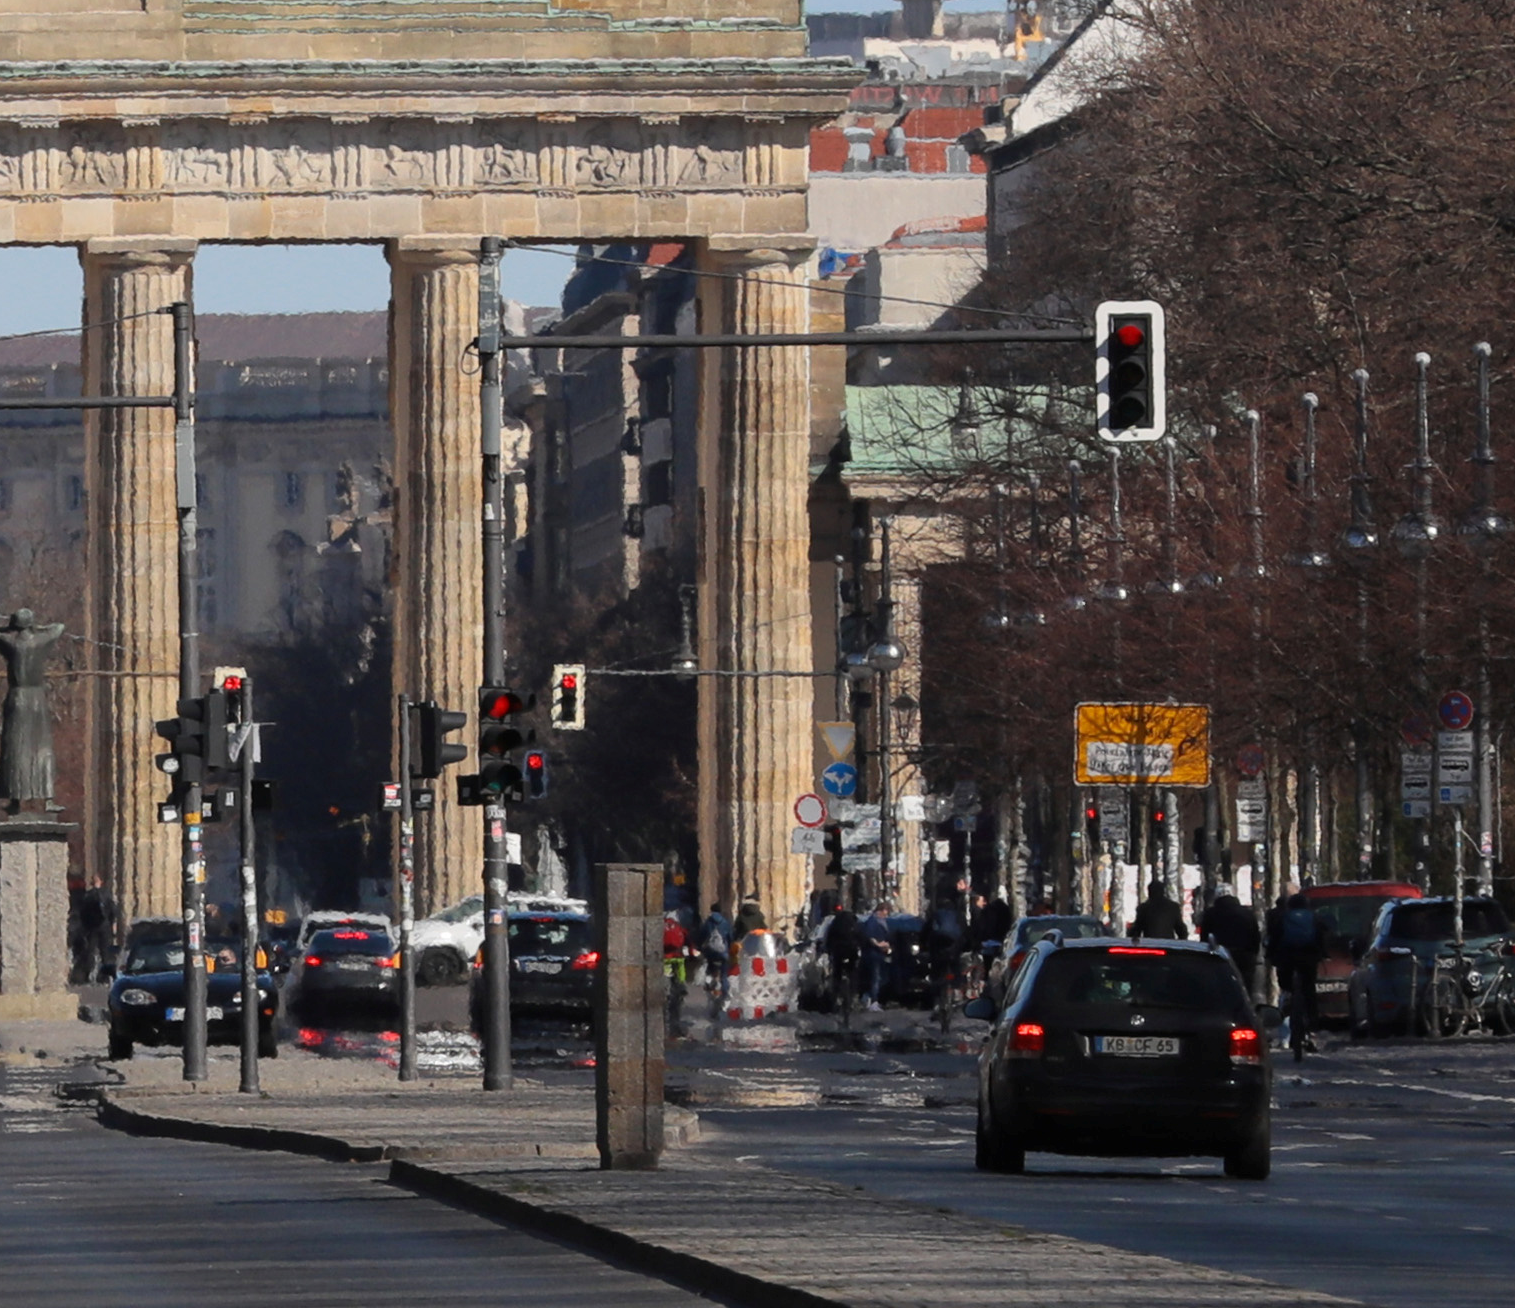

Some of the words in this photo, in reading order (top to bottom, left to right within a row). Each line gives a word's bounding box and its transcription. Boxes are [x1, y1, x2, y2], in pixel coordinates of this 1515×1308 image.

[1106, 1038, 1125, 1052] KB
[1134, 1038, 1153, 1052] CF
[1156, 1039, 1174, 1053] 65
